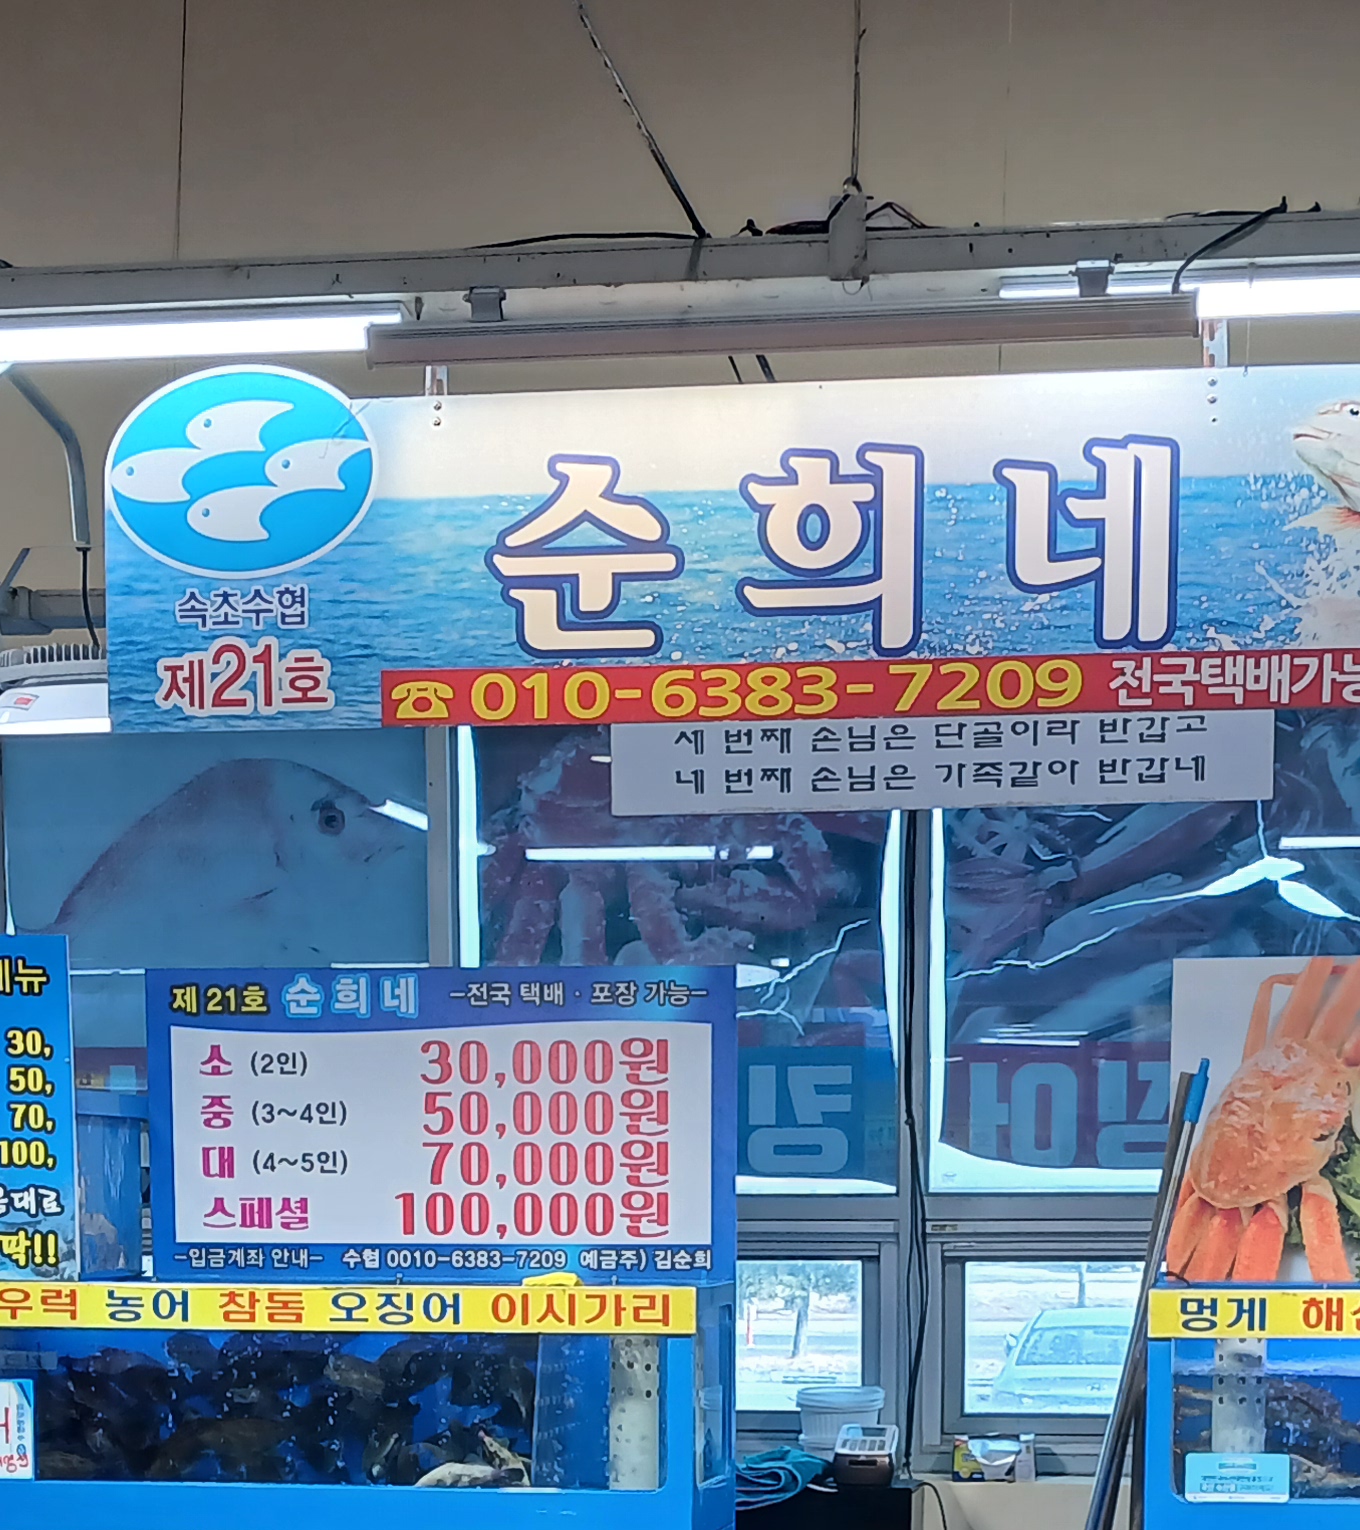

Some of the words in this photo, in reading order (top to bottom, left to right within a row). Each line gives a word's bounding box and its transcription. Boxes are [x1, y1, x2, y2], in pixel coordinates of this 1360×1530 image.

[485, 434, 1183, 661] 순희네
[176, 585, 308, 630] 속초수협
[159, 640, 332, 711] 제21호
[470, 662, 1086, 722] 010-6383-7209
[724, 728, 793, 755] 번째
[811, 725, 917, 753] 손님은
[933, 719, 1082, 754] 단골이라
[1097, 713, 1210, 746] 반갑고
[674, 767, 706, 796] 네
[724, 766, 793, 795] 번째
[811, 764, 917, 793] 손님은
[934, 759, 1082, 790] 가족같아
[1097, 754, 1208, 786] 반갑네
[171, 985, 198, 1013] 제
[206, 985, 267, 1013] 21호
[282, 973, 420, 1019] 순희네
[519, 983, 564, 1007] 택배
[590, 984, 637, 1008] 포장
[6, 1029, 52, 1058] 30,
[199, 1043, 233, 1077] 소
[250, 1050, 308, 1077] (2인)
[419, 1036, 670, 1089] 30,000원
[8, 1066, 55, 1095] 50,
[9, 1103, 55, 1132] 70,
[199, 1094, 236, 1130] 중
[251, 1100, 348, 1127] (3~4인)
[422, 1089, 670, 1138] 50,000원
[201, 1146, 236, 1180] 대
[252, 1148, 349, 1175] (4~5인)
[422, 1139, 670, 1189] 70,000원
[202, 1197, 310, 1232] 스페셜
[394, 1190, 670, 1240] 100,000원
[342, 1247, 381, 1269] 수협
[386, 1248, 567, 1270] 0010-6383-7209
[579, 1248, 647, 1270] 예금주)
[653, 1248, 712, 1271] 김순희
[104, 1289, 190, 1323] 농어
[219, 1290, 305, 1324] 참돔
[328, 1290, 462, 1326] 오징어
[491, 1291, 673, 1328] 이시가리
[1178, 1296, 1269, 1334] 멍게
